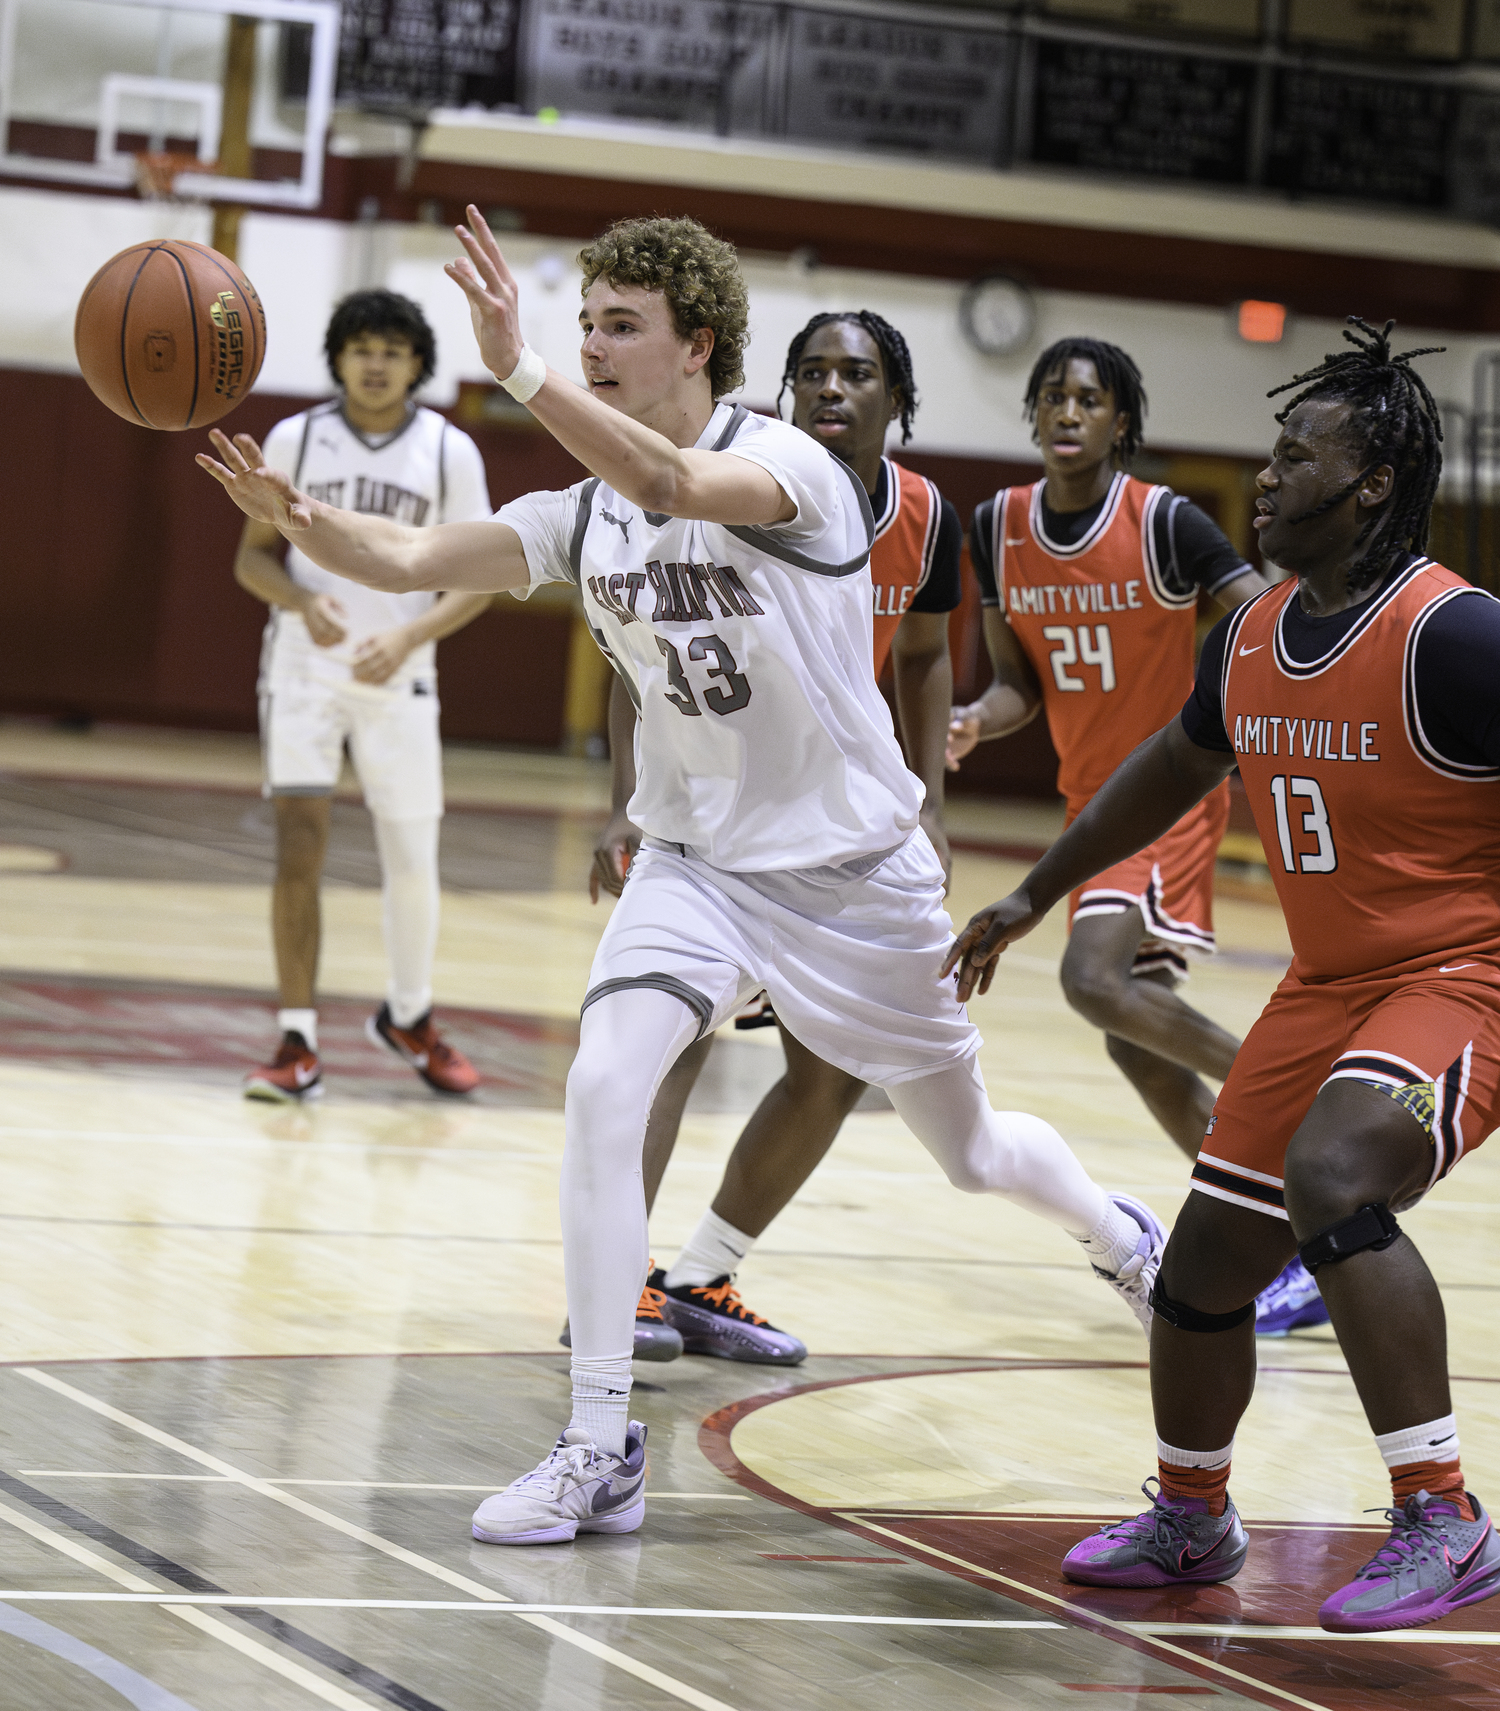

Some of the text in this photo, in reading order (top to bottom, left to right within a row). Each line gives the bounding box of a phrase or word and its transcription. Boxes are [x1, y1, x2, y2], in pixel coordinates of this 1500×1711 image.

[217, 290, 244, 399] LEGACY
[1008, 579, 1144, 616] AMITYVILLE
[654, 634, 752, 716] 33
[1042, 624, 1117, 693] 24
[1234, 714, 1381, 762] AMITYVILLE
[1270, 774, 1338, 874] 13
